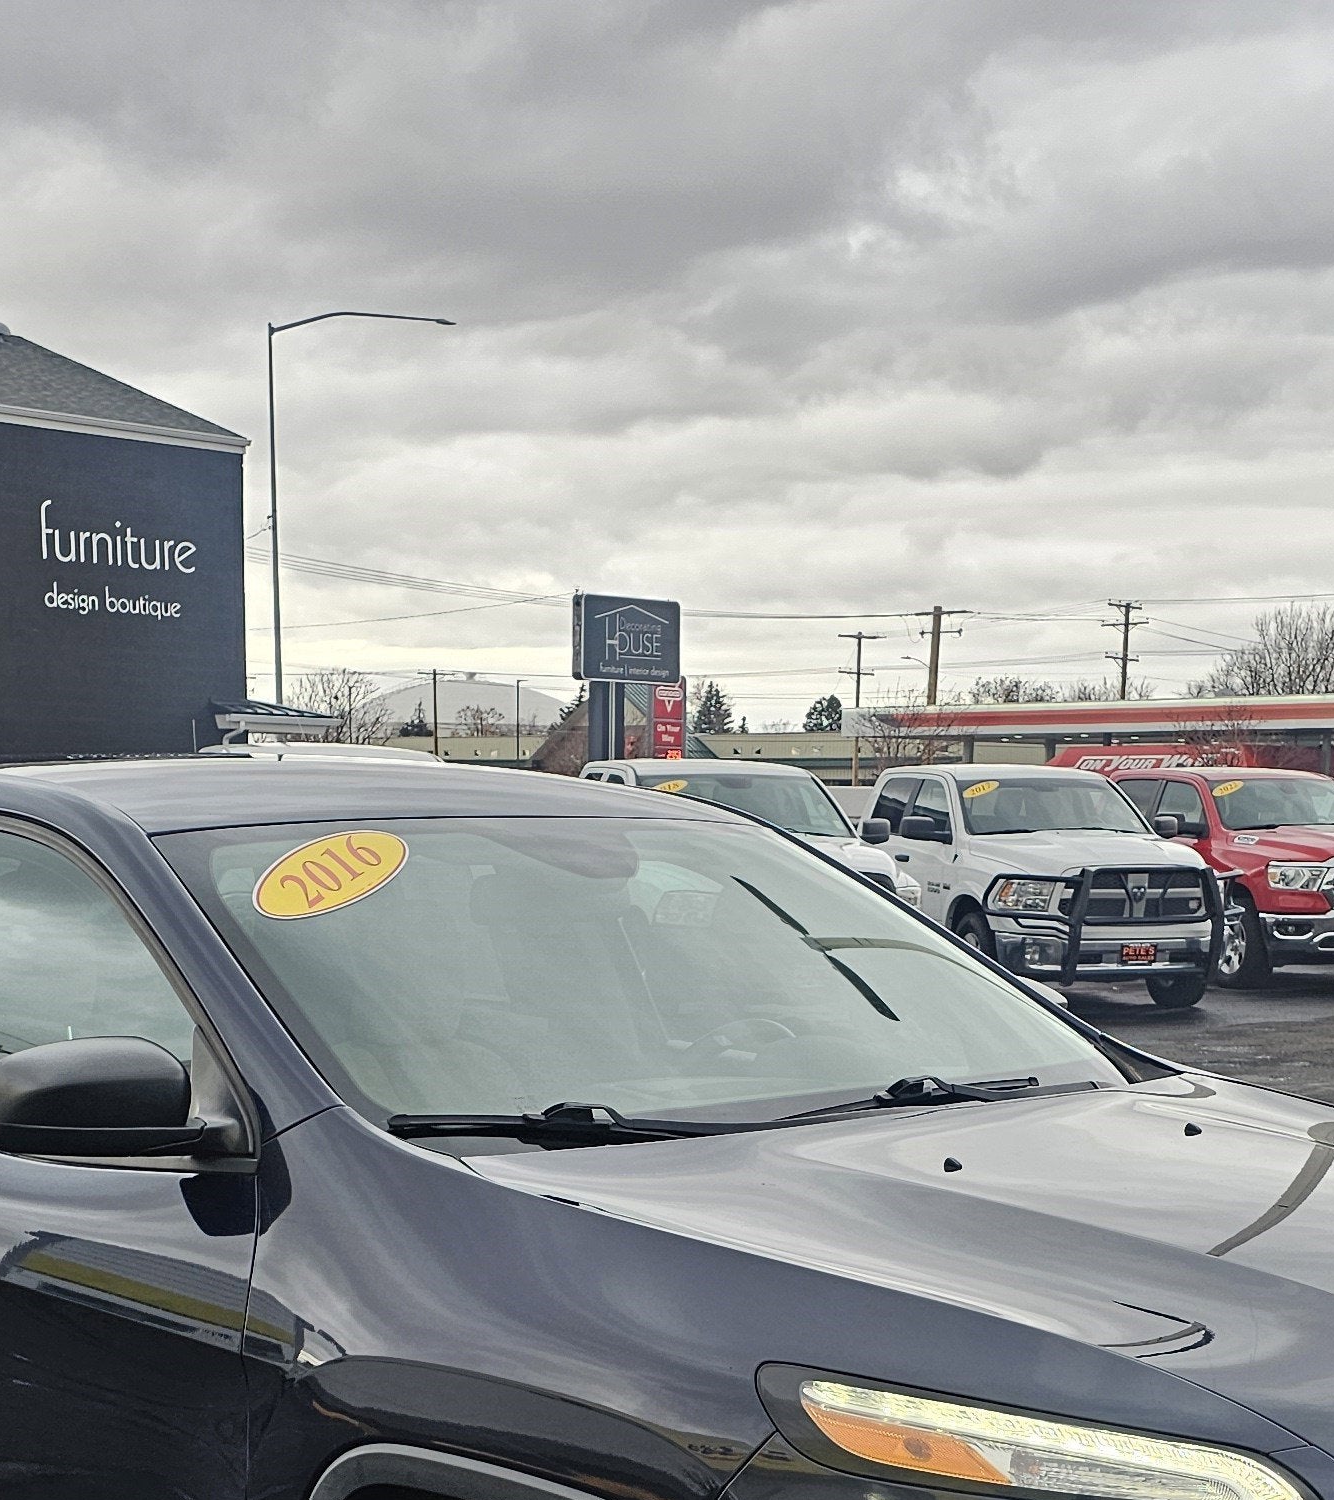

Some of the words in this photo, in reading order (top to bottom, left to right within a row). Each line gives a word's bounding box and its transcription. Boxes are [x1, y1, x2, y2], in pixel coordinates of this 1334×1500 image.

[40, 500, 197, 573] furniture
[44, 581, 99, 615] design
[105, 585, 182, 620] boutique
[605, 613, 662, 661] HOUSE
[619, 616, 662, 634] Decorating
[1103, 755, 1157, 771] YOUR
[280, 835, 382, 909] 2016
[1122, 946, 1155, 955] PETE'S
